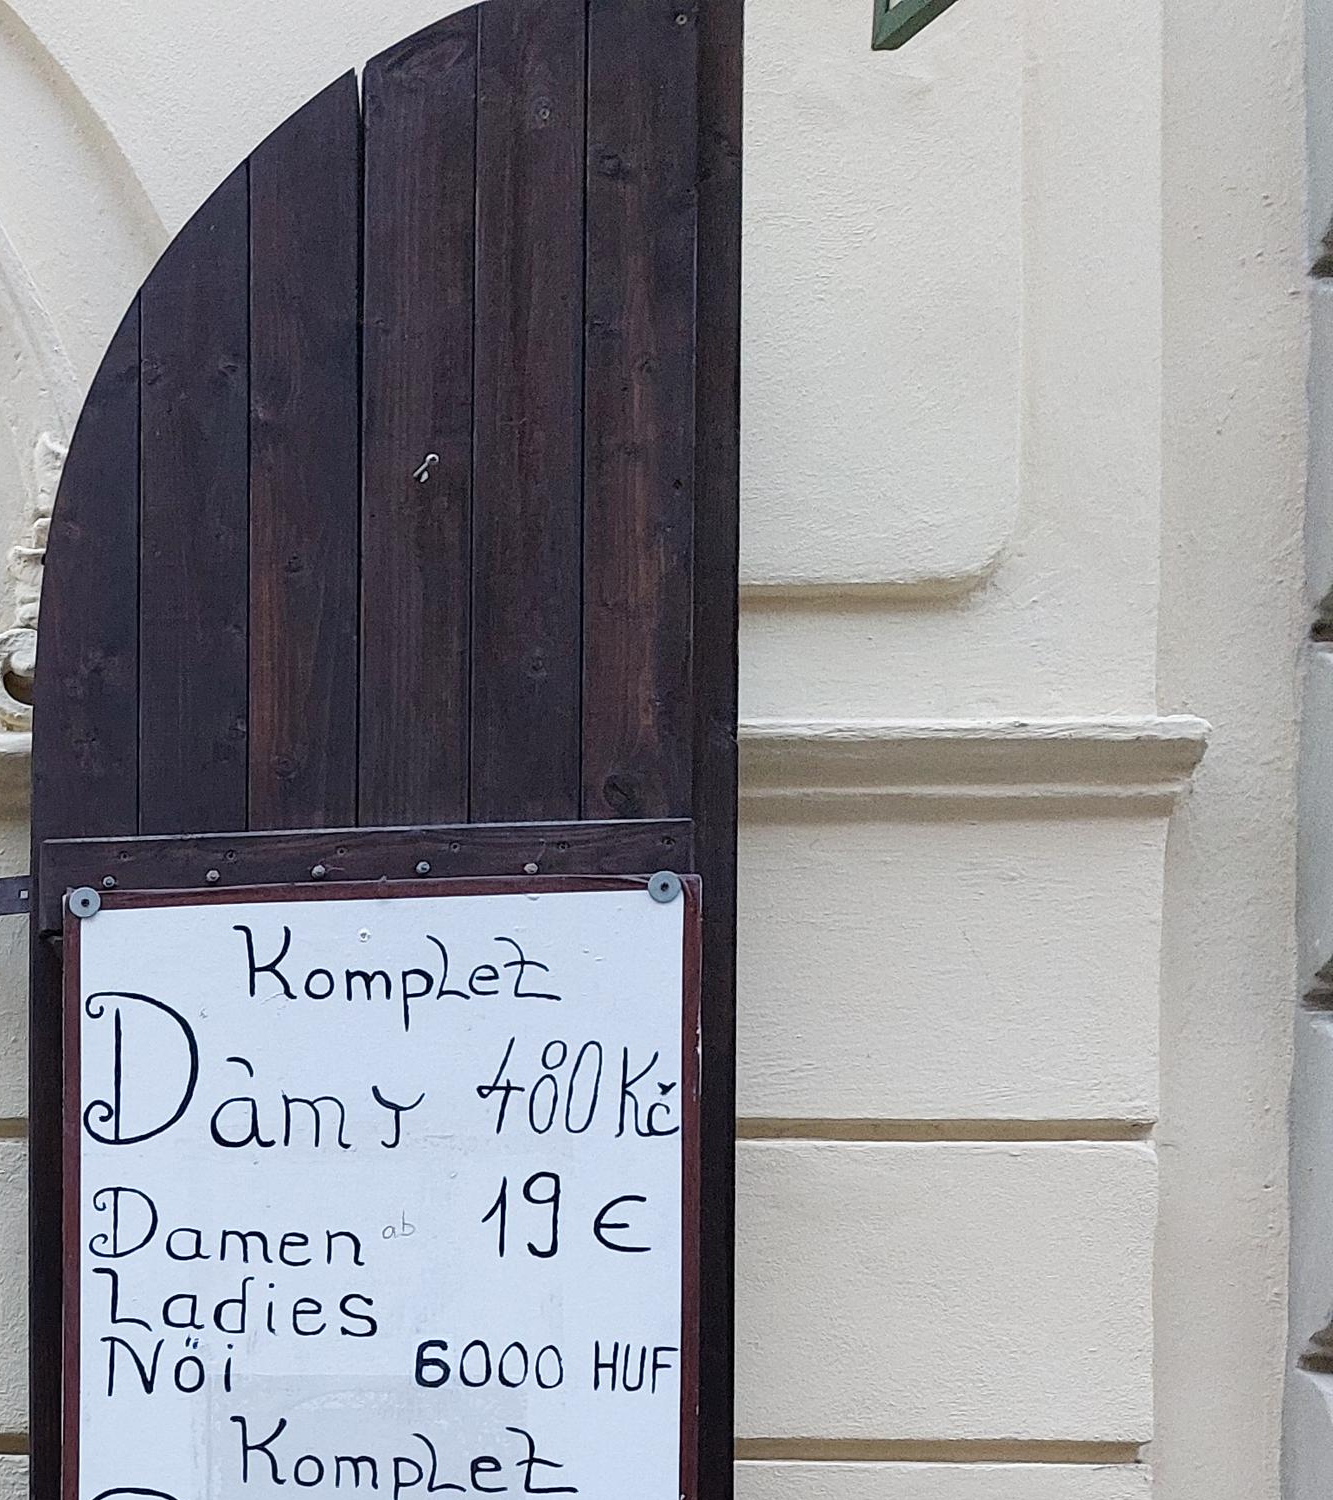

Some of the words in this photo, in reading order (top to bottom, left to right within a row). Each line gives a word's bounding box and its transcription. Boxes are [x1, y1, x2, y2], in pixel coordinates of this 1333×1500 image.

[477, 1037, 602, 1134] 480
[89, 1187, 364, 1266] Damen
[482, 1172, 560, 1258] 19
[594, 1195, 651, 1252] €
[92, 1268, 378, 1338] Ladies
[415, 1340, 563, 1388] 6000
[594, 1341, 678, 1393] HUF
